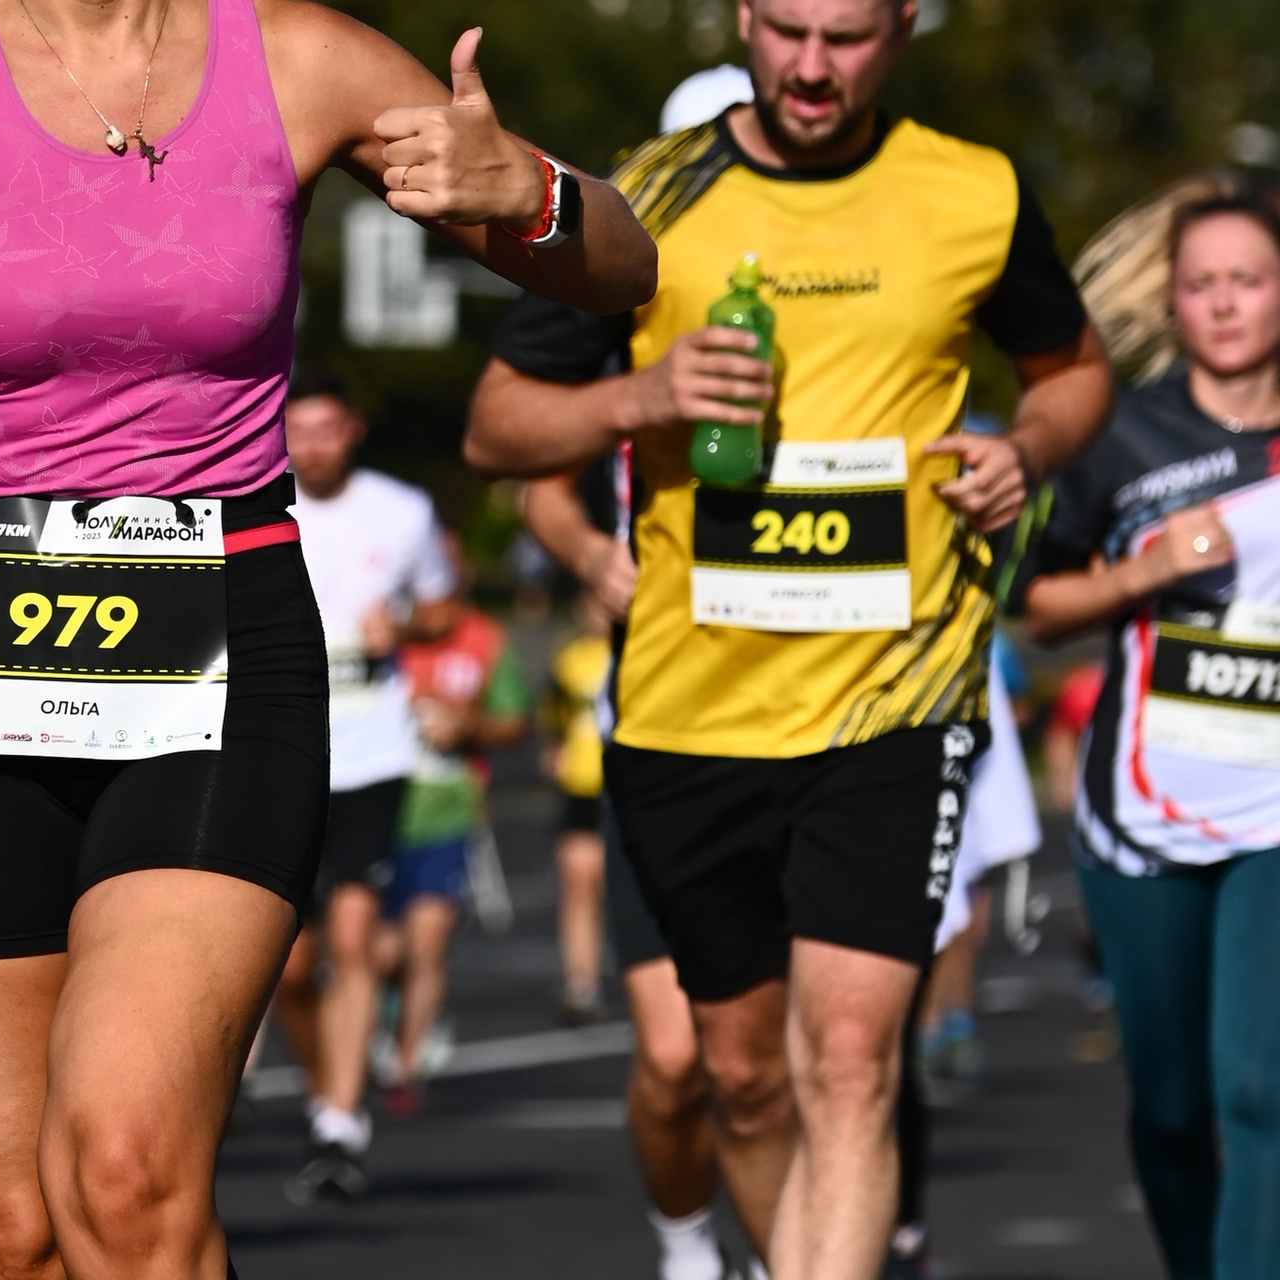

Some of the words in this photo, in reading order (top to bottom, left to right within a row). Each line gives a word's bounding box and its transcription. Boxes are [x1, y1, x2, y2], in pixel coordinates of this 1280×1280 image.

[131, 517, 204, 526] МИНСЙ
[81, 532, 102, 541] 2023
[109, 523, 204, 542] МАРАФОН
[750, 508, 851, 555] 240
[9, 592, 139, 649] 979
[1186, 649, 1280, 701] 1071
[40, 699, 100, 717] ОЛЬГА
